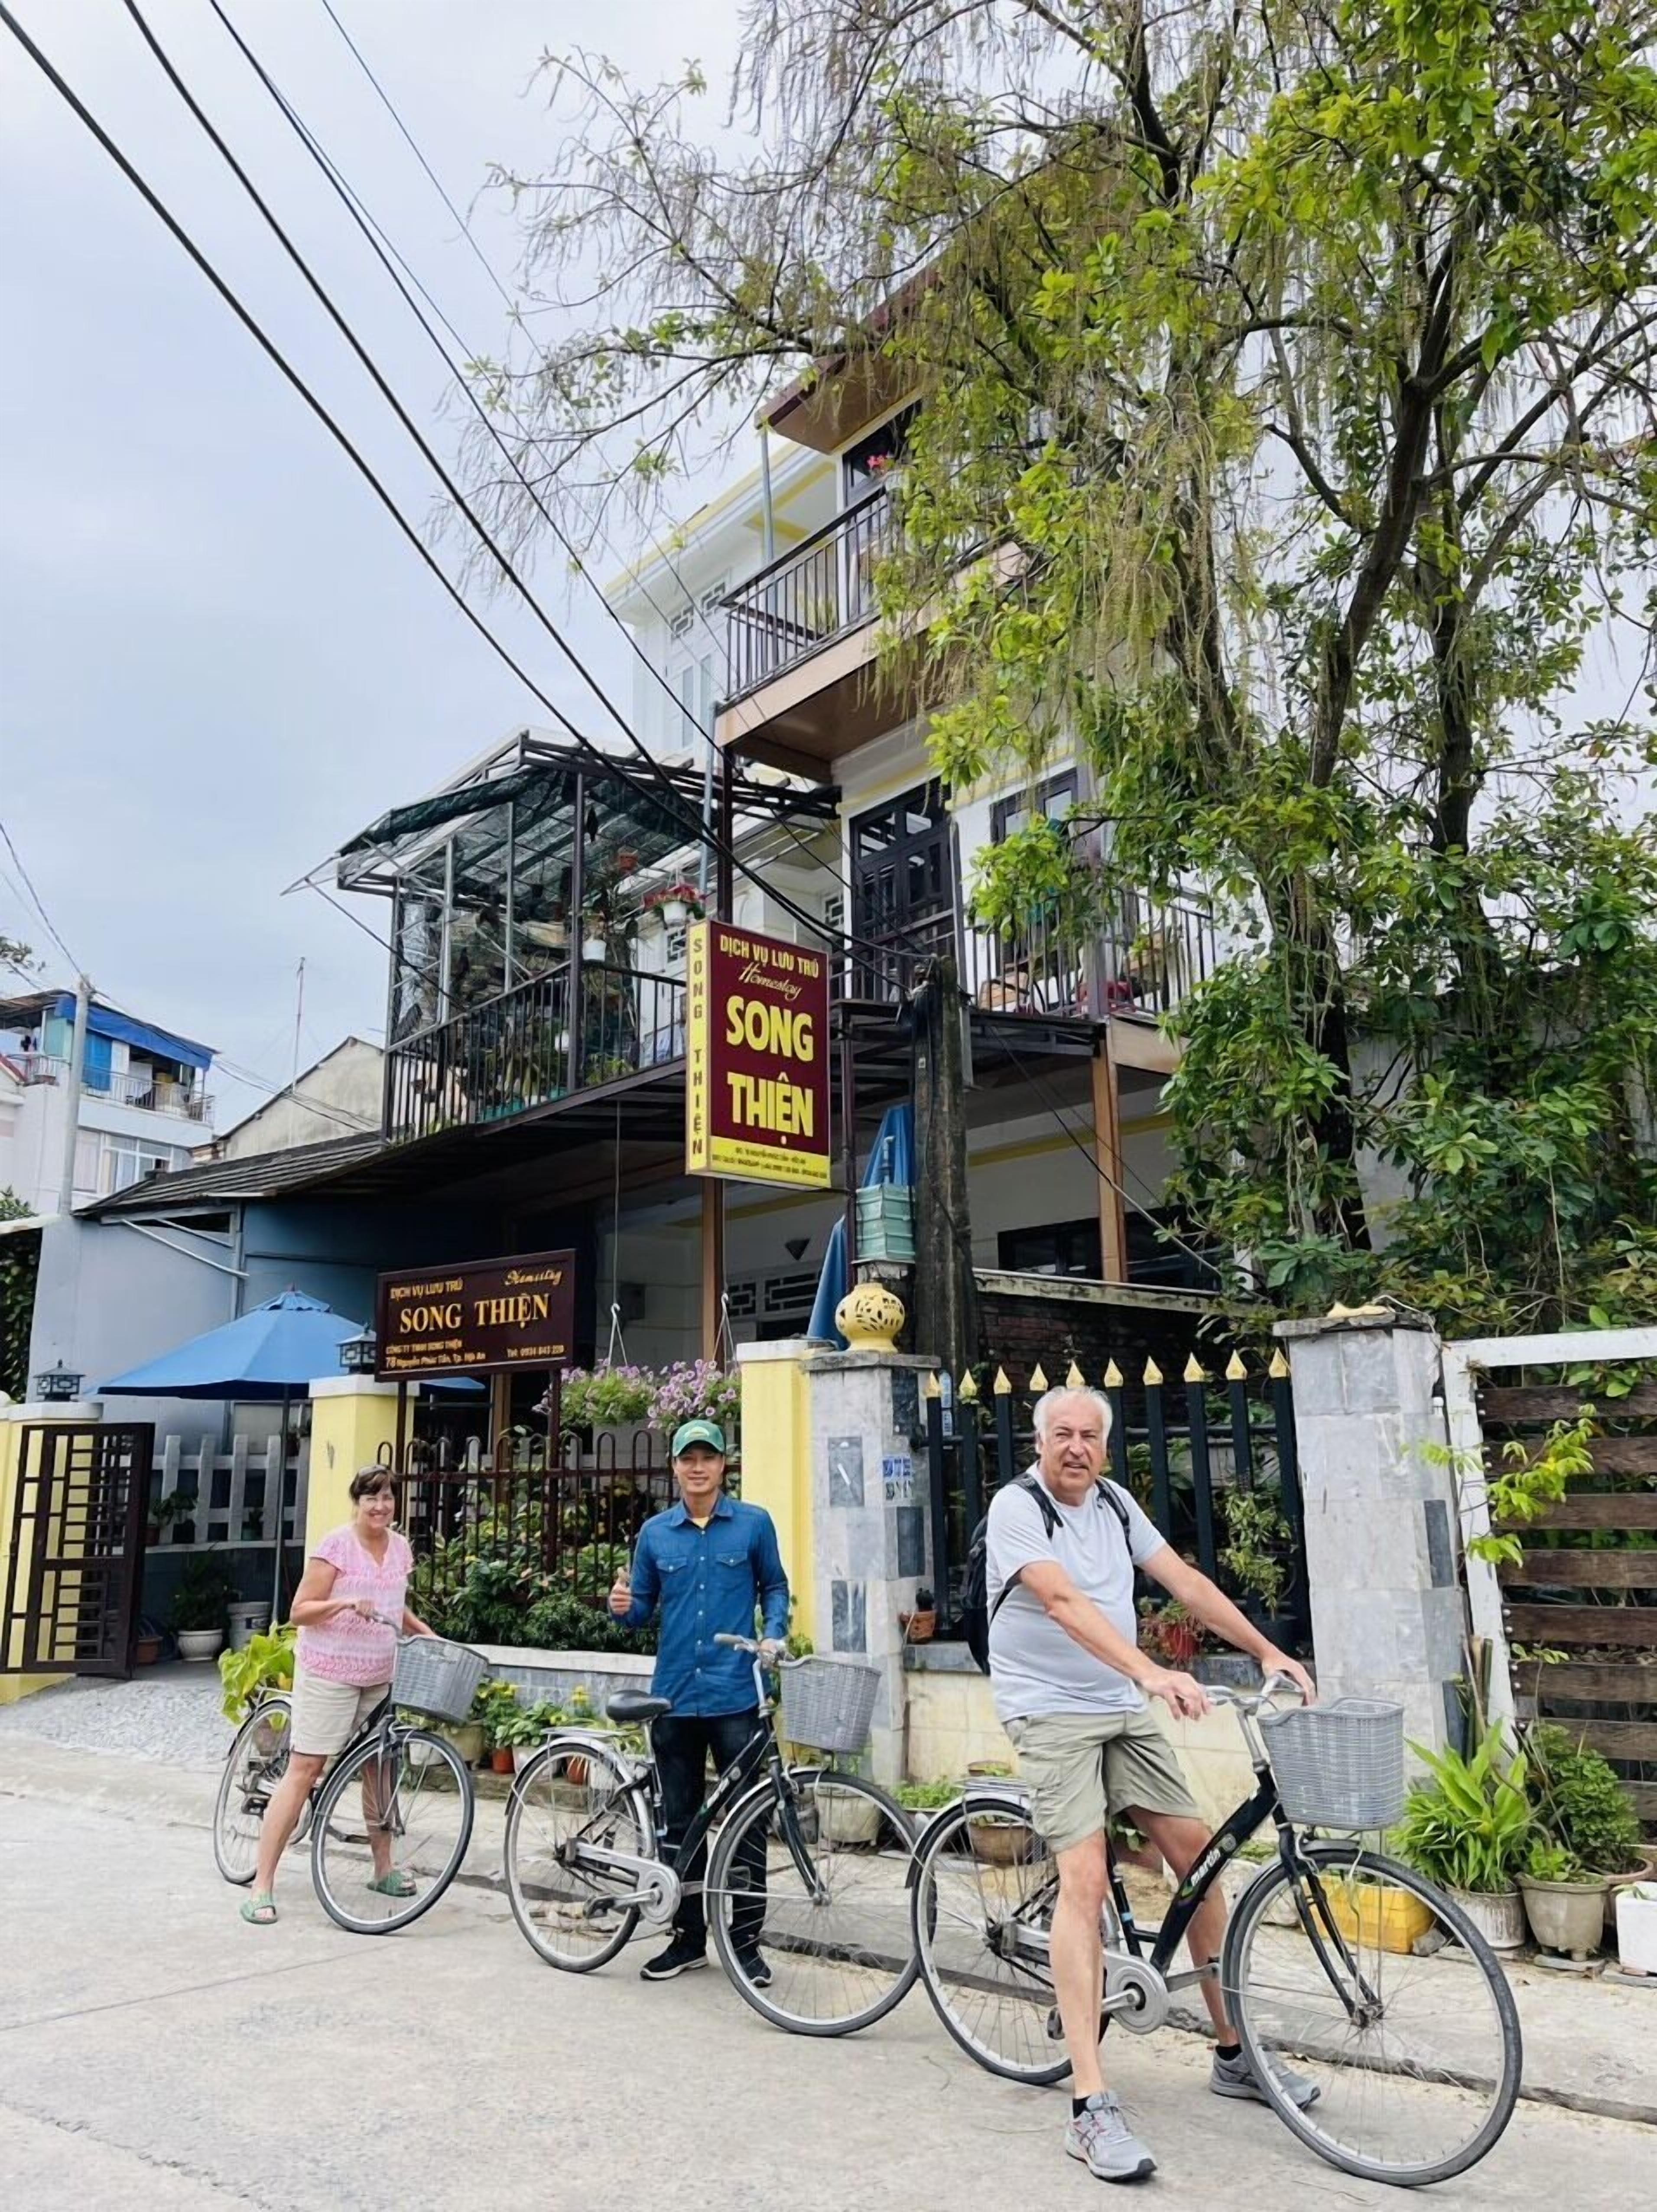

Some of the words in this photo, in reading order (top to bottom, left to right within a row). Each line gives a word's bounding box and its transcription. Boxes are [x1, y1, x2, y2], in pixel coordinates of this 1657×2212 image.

[720, 934, 749, 958] DỊCH
[752, 943, 769, 967] VỤ
[693, 937, 702, 1019] SONG
[738, 961, 803, 1002] Homestay
[726, 995, 814, 1062] SONG
[727, 1071, 814, 1145] THIỆN
[400, 1303, 465, 1334] SONG
[474, 1293, 550, 1329] THIỆN
